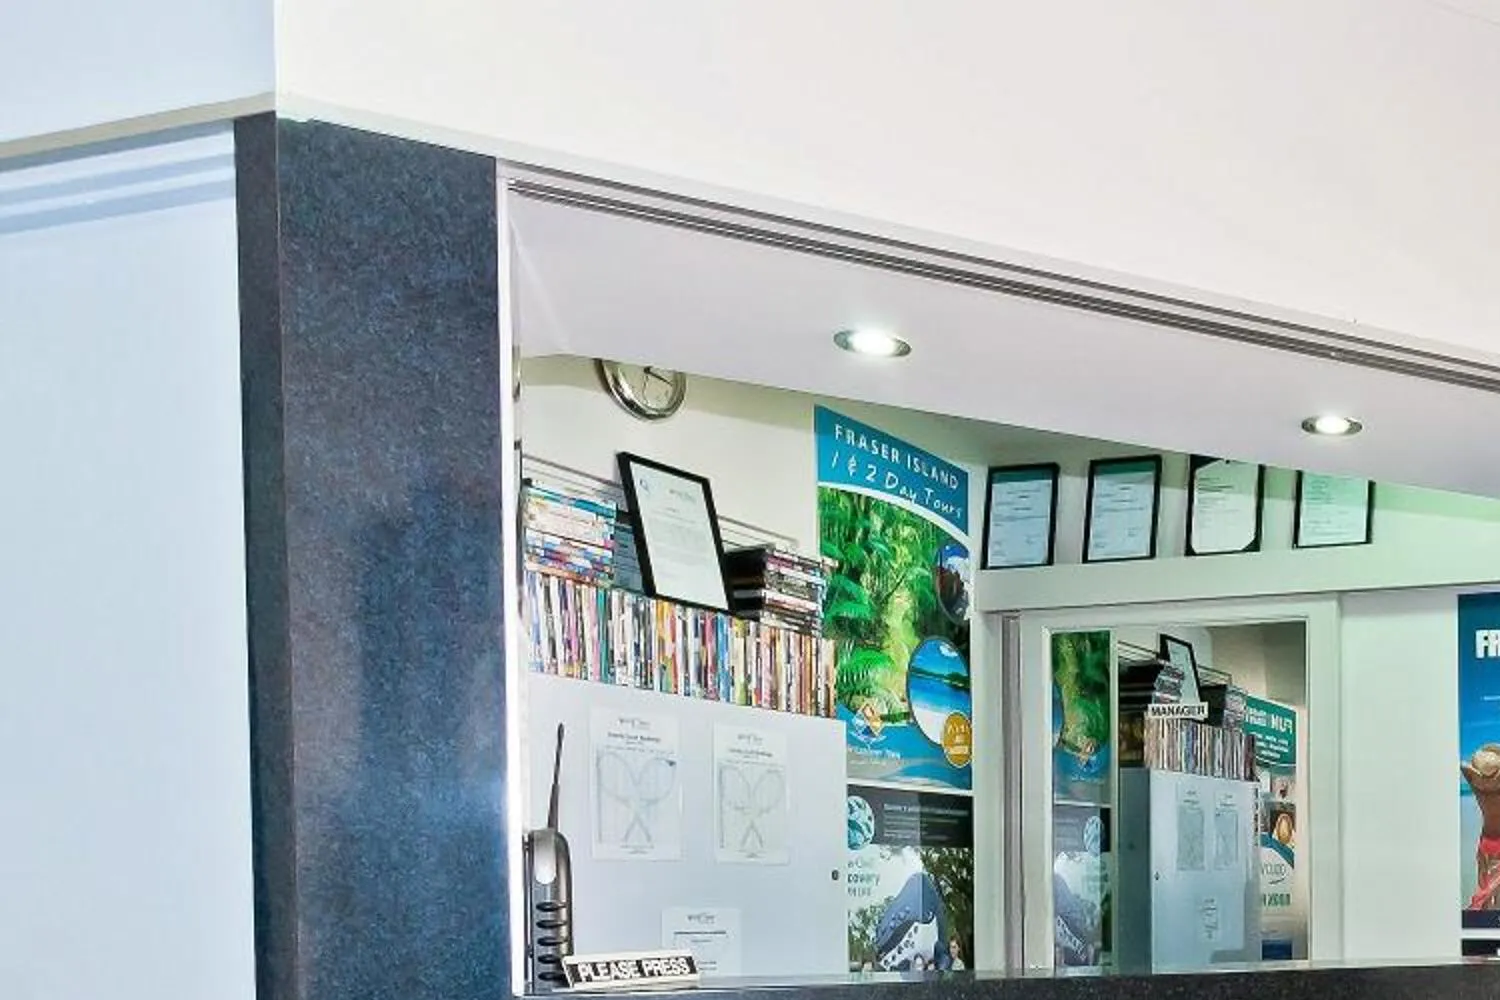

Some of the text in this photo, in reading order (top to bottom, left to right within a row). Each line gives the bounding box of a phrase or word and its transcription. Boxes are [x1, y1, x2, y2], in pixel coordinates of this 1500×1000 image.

[834, 423, 959, 490] FRASER ISLAND
[847, 456, 858, 477] &
[865, 464, 876, 482] 2
[885, 471, 917, 504] Day
[924, 487, 962, 519] Tours
[1151, 704, 1205, 718] MANAGER
[577, 958, 640, 984] PLEASE
[642, 955, 693, 980] PRESS
